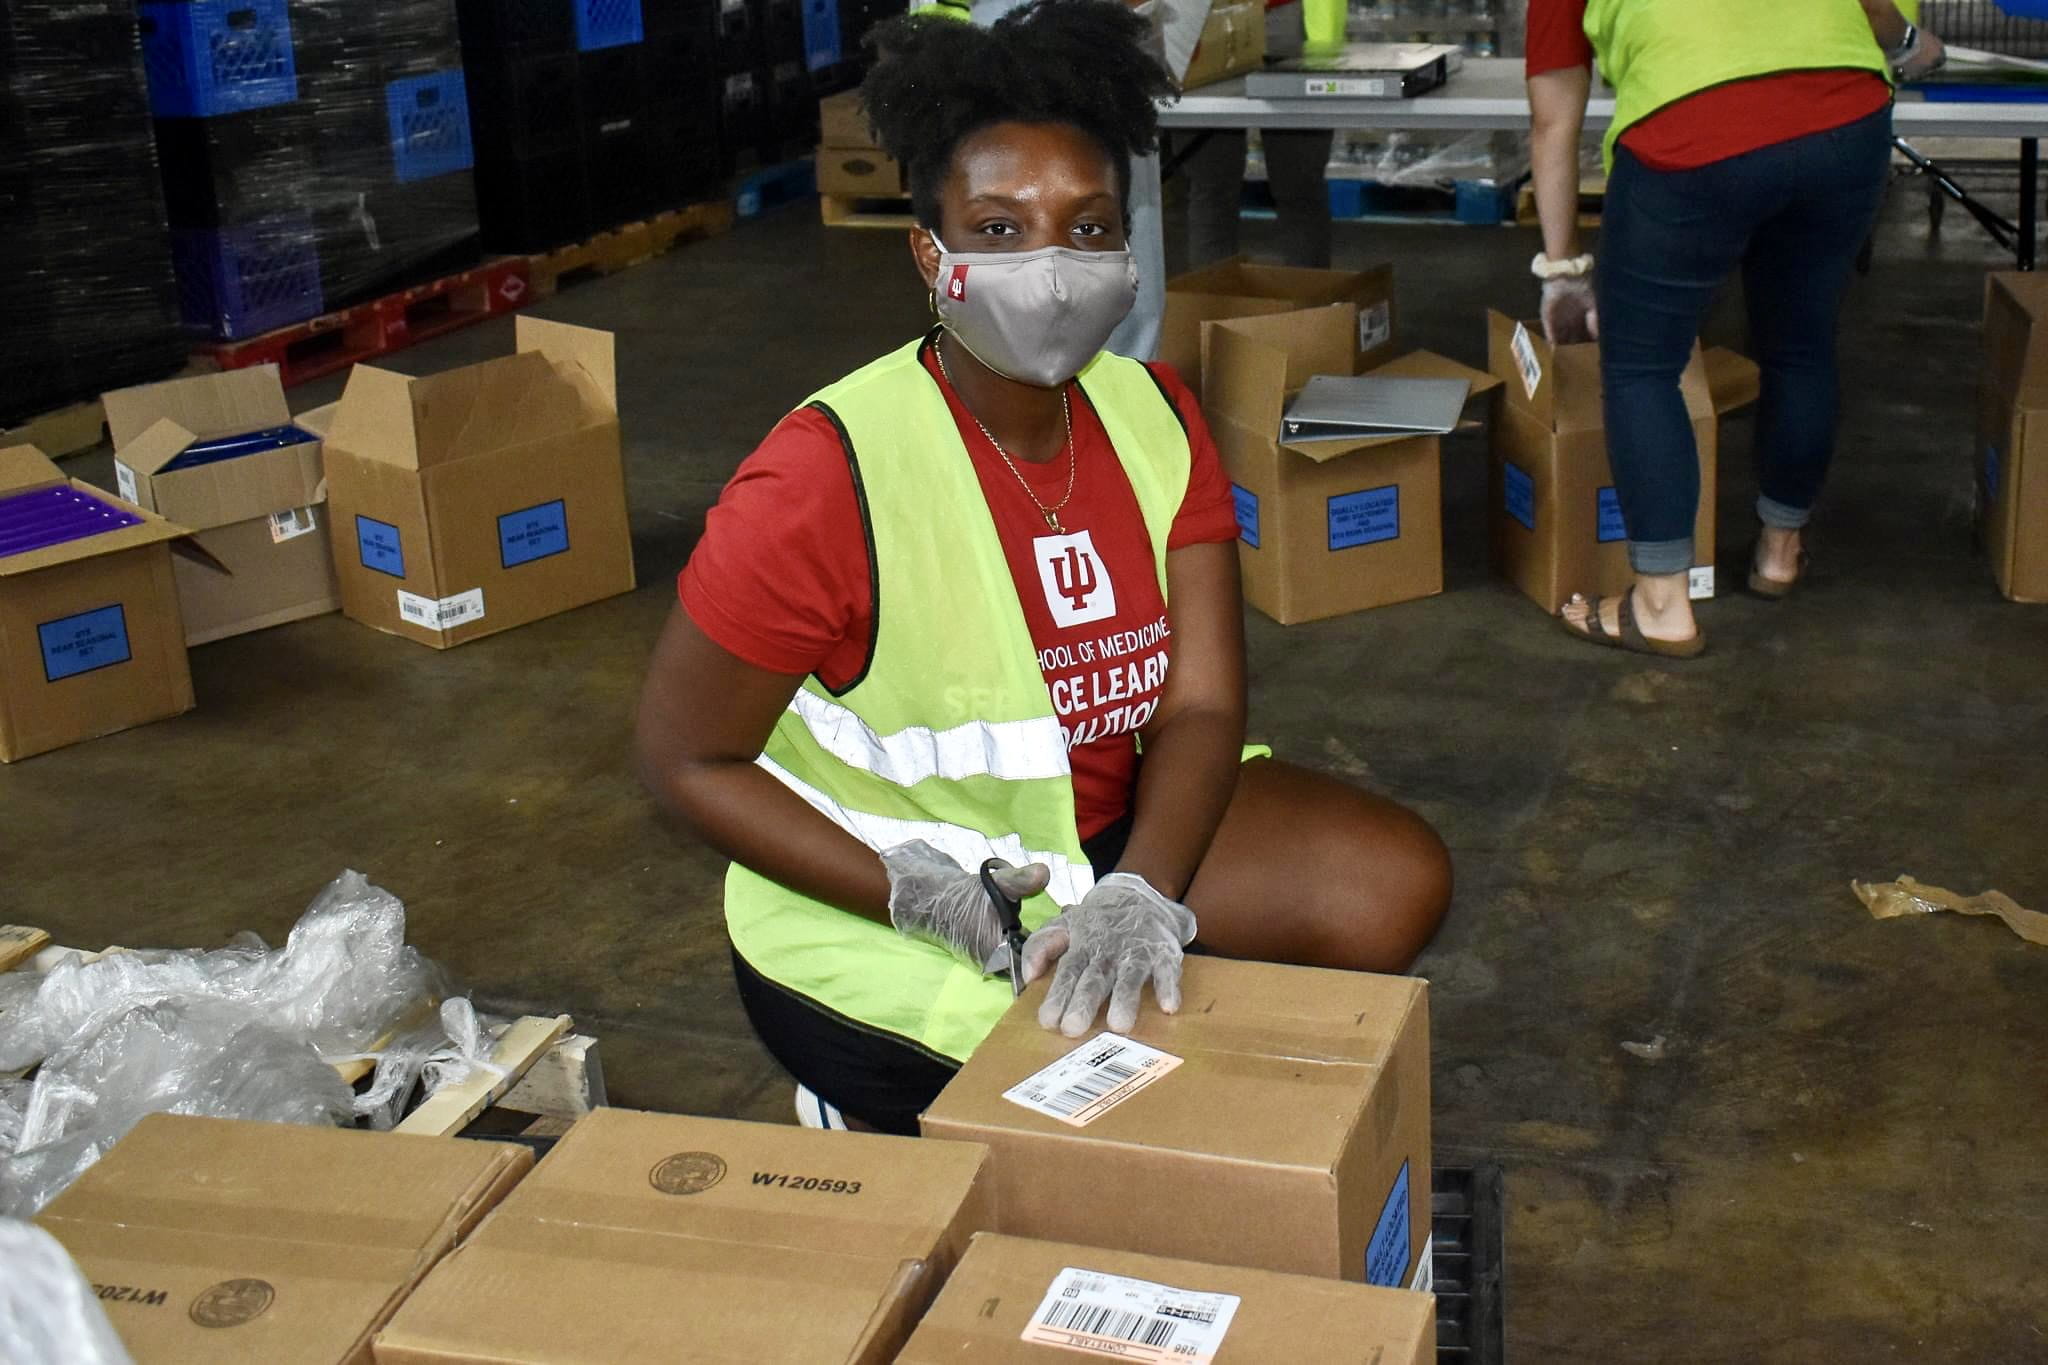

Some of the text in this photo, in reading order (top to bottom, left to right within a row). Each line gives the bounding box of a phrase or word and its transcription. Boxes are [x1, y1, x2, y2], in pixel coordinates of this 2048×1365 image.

[1079, 641, 1096, 663] OF
[1099, 616, 1171, 659] MEDICINE
[1046, 675, 1088, 716] CE
[752, 1172, 862, 1195] W120593
